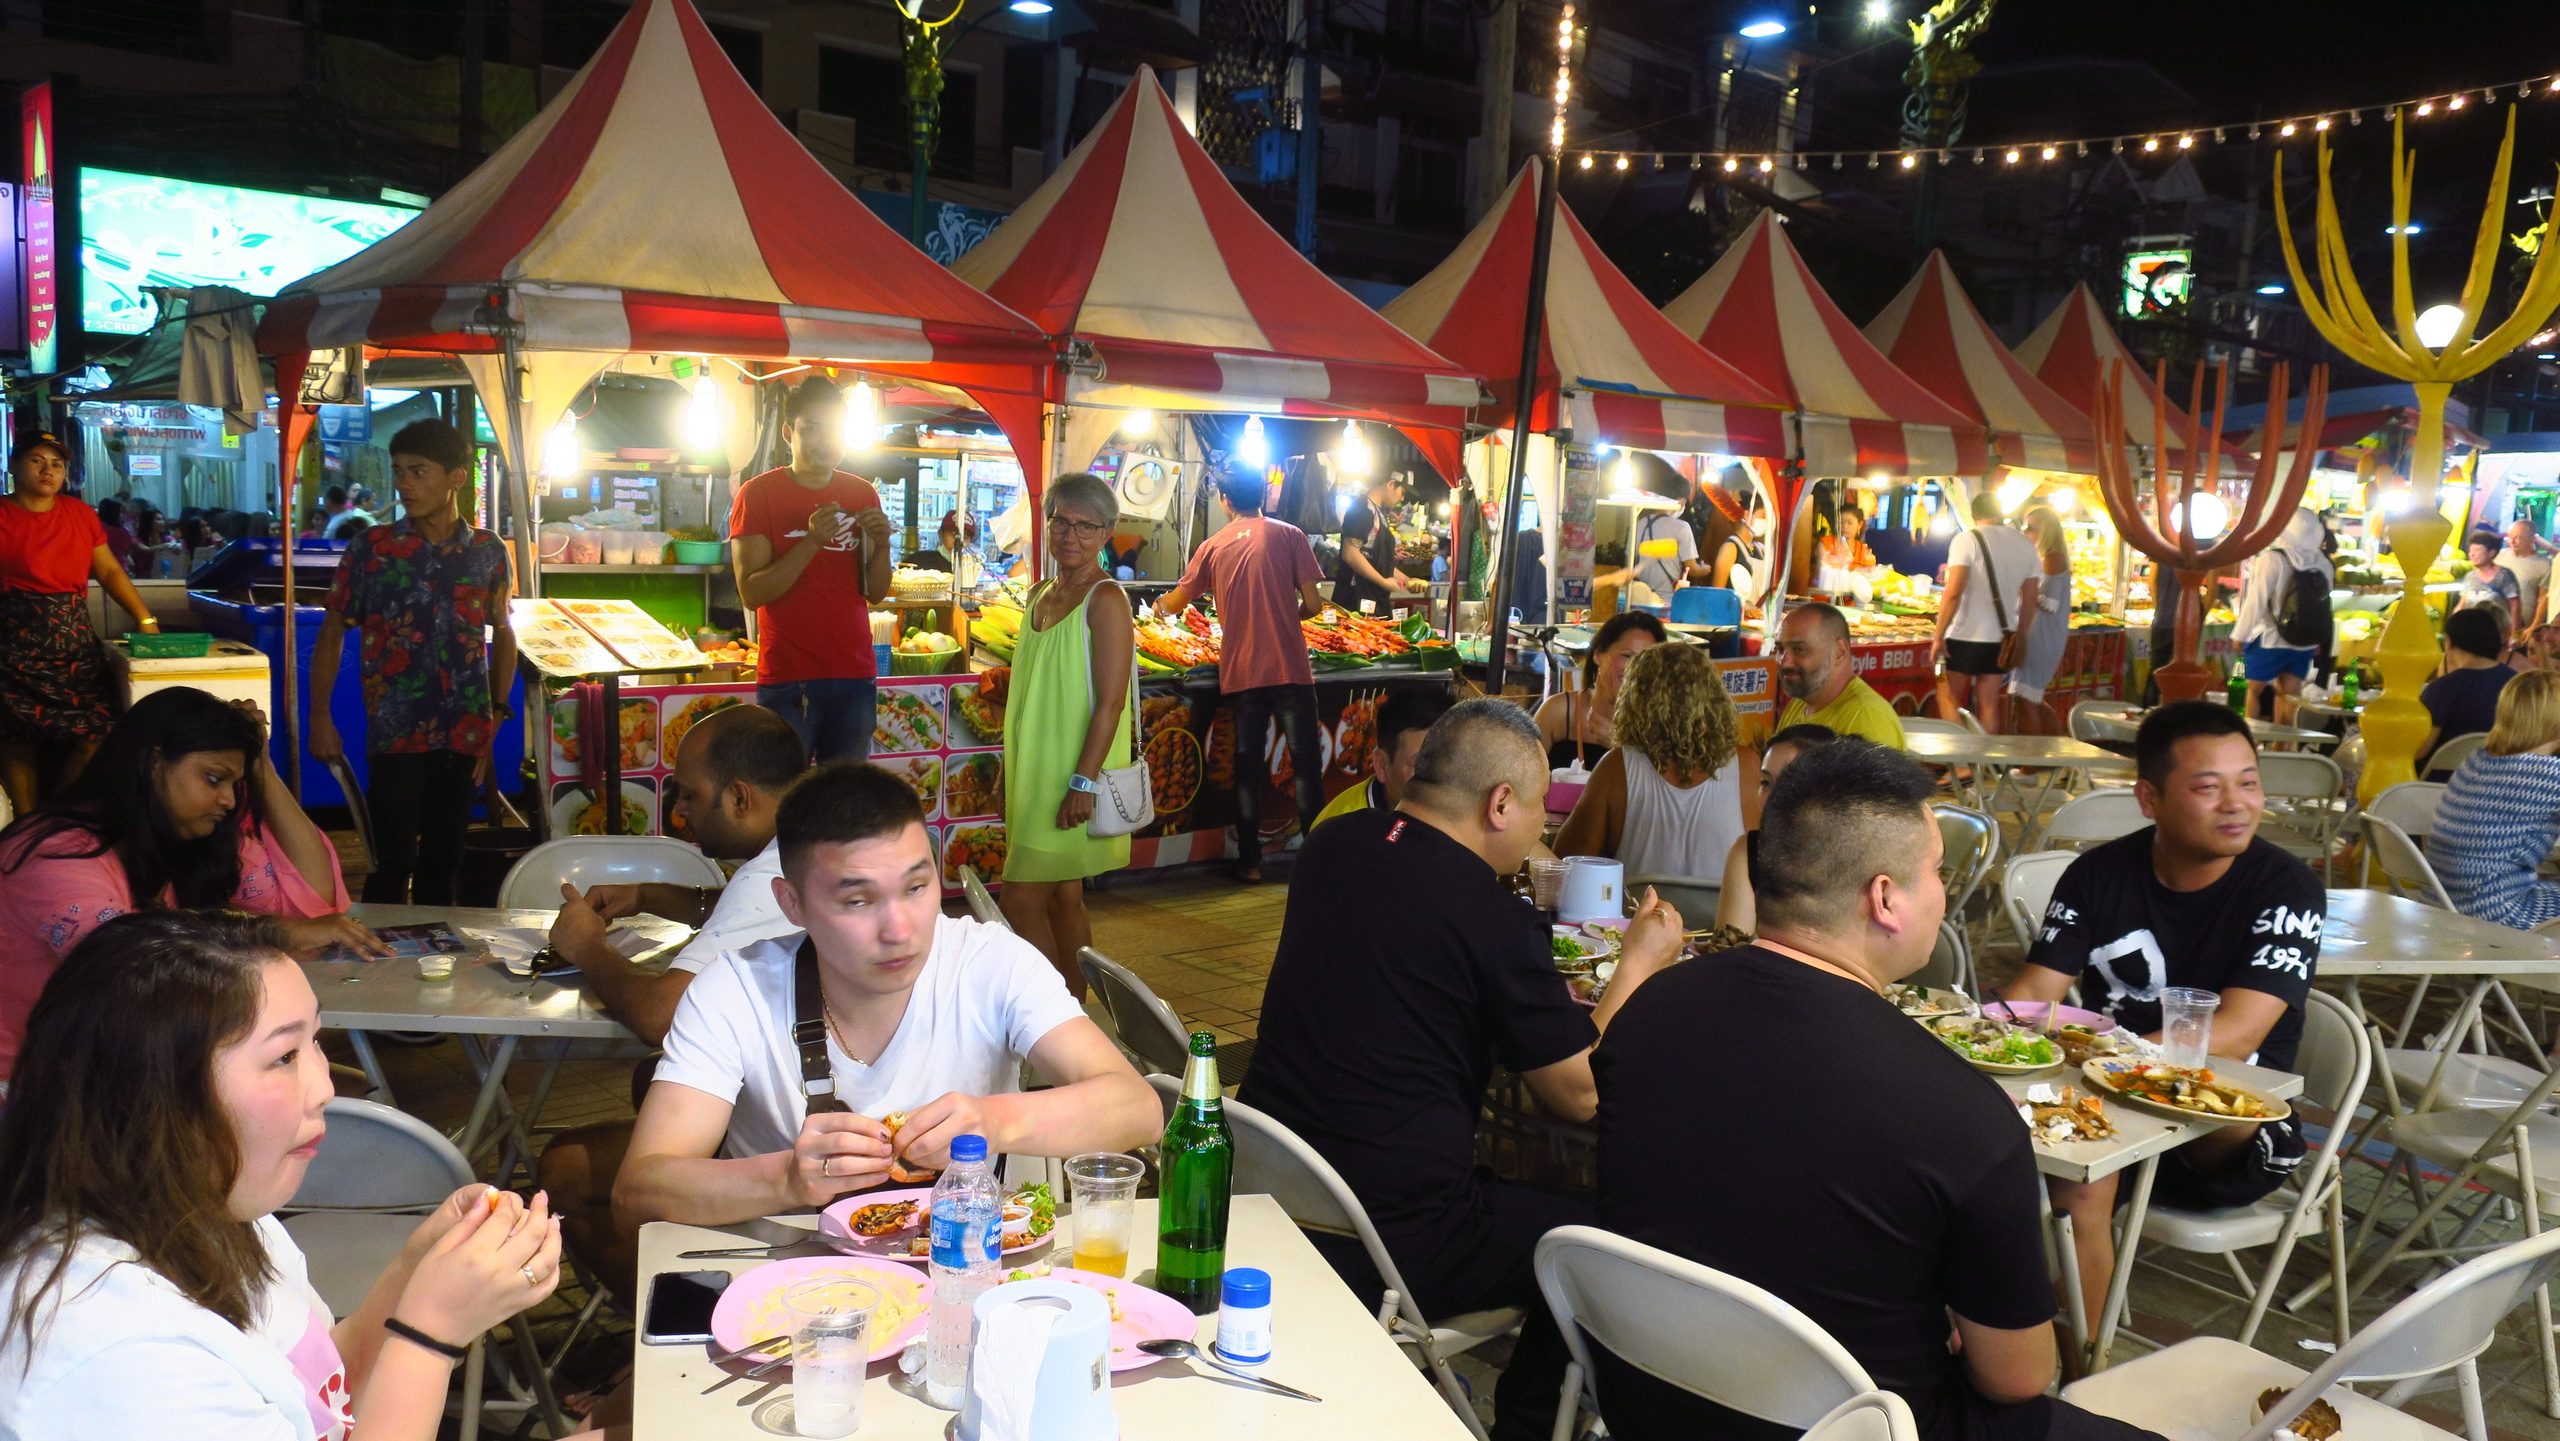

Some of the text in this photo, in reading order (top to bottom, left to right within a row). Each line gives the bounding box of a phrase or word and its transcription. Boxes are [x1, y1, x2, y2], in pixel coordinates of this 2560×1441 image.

[96, 319, 139, 333] SCRUB
[1568, 578, 1584, 587] salt
[1850, 651, 1877, 675] tyle
